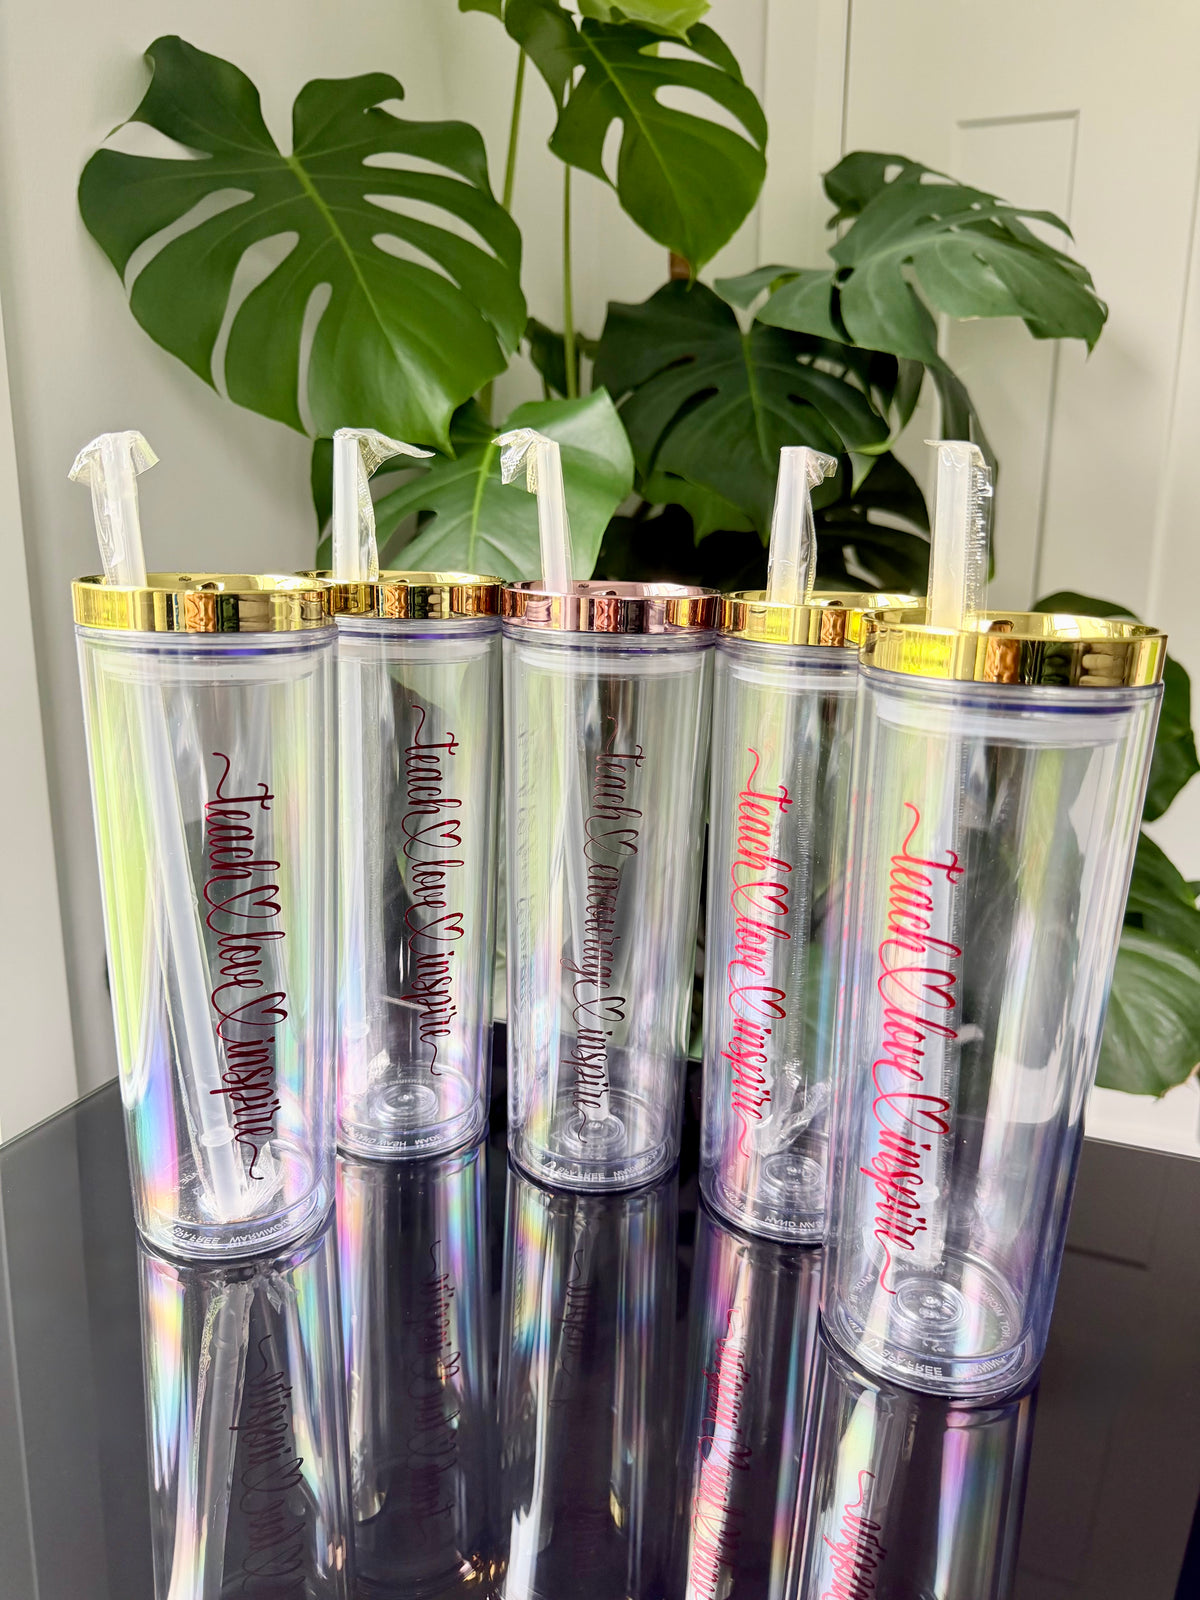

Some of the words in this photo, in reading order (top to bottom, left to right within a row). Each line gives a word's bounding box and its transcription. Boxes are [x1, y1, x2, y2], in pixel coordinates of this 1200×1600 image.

[204, 752, 281, 881] teach
[404, 705, 462, 815] teach
[593, 716, 646, 820] teach
[737, 748, 793, 873] teach
[411, 860, 464, 910] love
[560, 864, 621, 990] encourage
[887, 802, 964, 959] teach
[216, 931, 286, 989] love
[736, 914, 792, 978] love
[401, 950, 458, 1076] inspire
[883, 1004, 959, 1082] love
[209, 1036, 282, 1180] inspire
[561, 1030, 612, 1144] inspire
[721, 1018, 772, 1159] inspire
[860, 1127, 931, 1295] inspire
